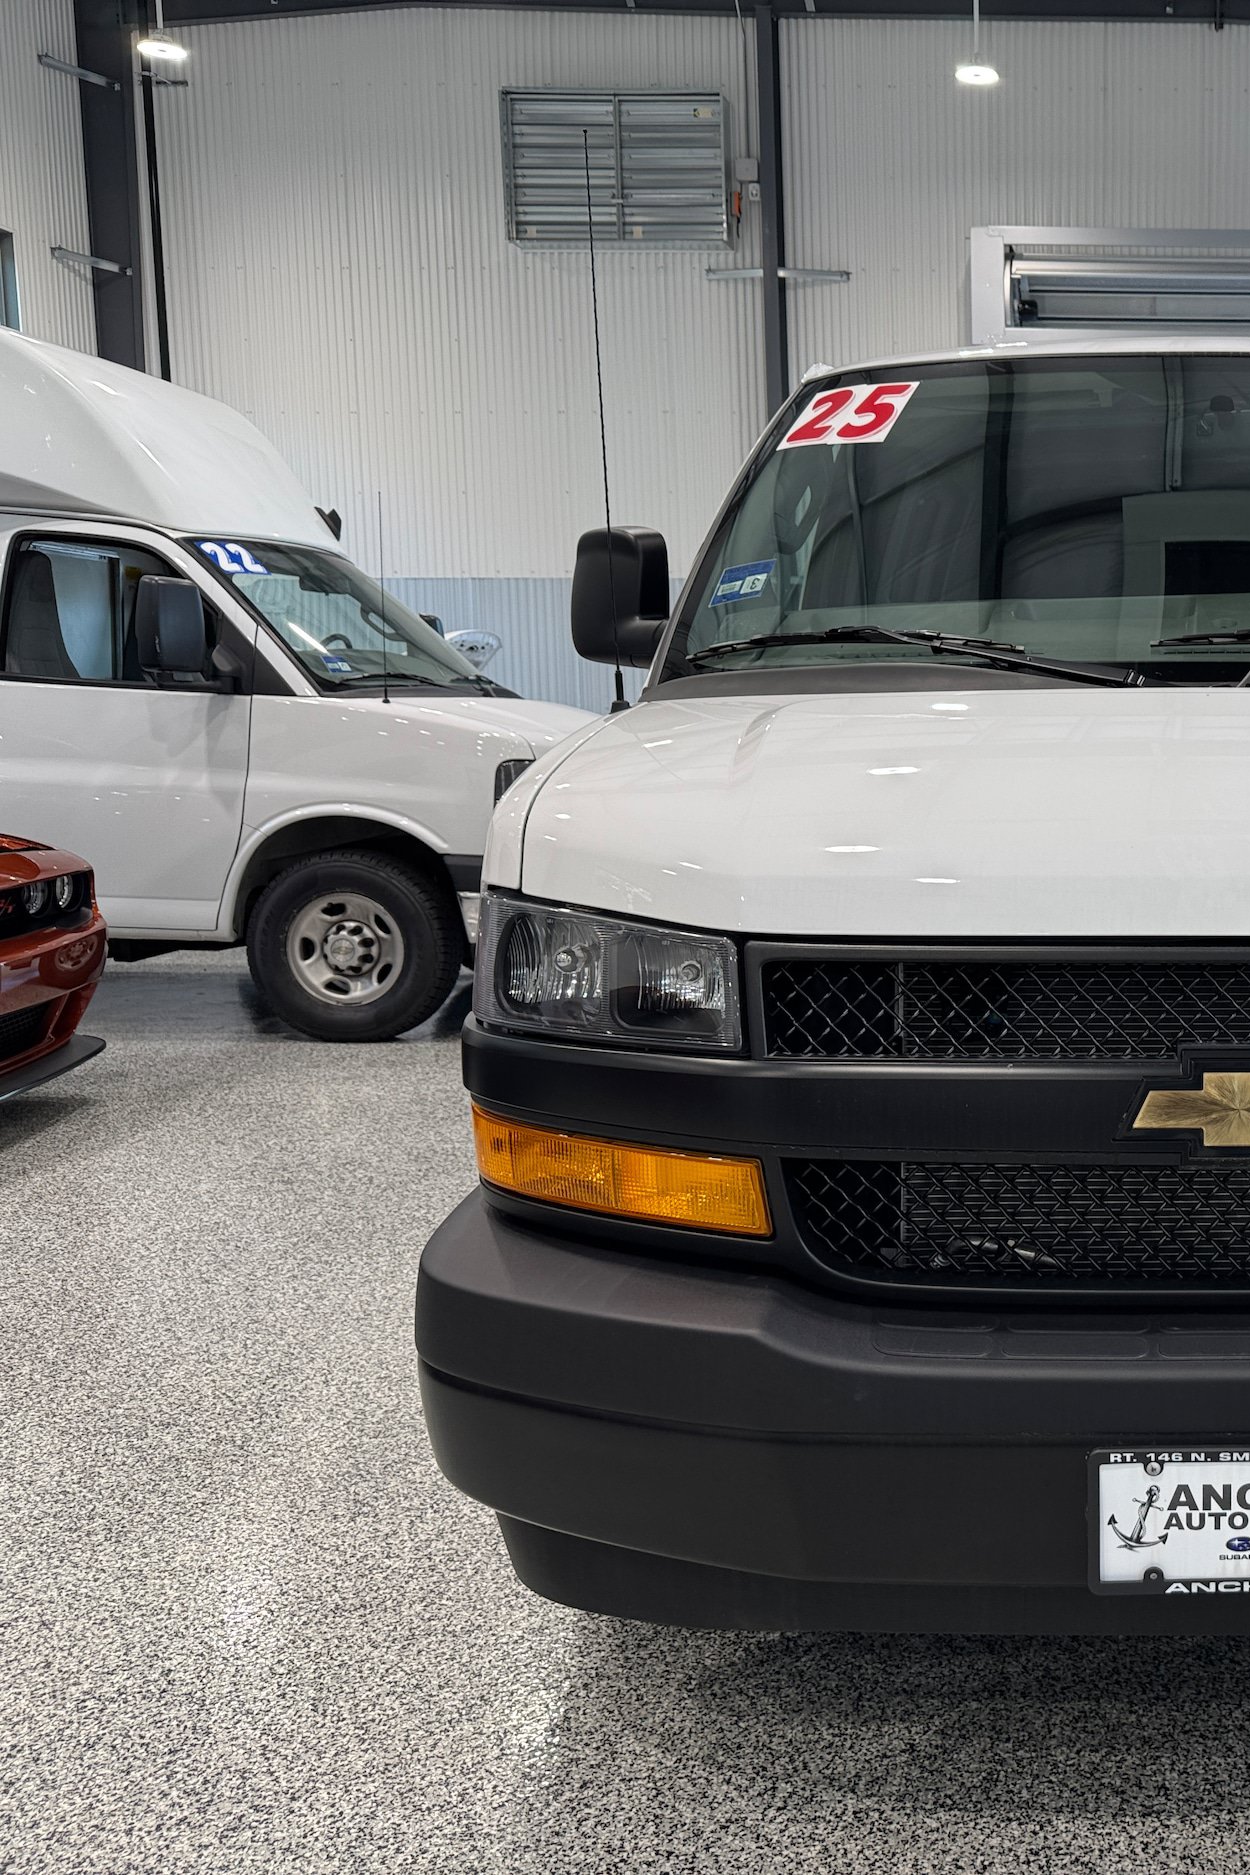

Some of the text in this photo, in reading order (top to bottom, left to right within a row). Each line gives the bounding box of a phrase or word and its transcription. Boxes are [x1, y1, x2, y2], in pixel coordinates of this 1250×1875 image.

[786, 384, 914, 444] 25
[200, 541, 268, 574] 22
[1109, 1452, 1137, 1463] RT.
[1145, 1452, 1183, 1462] 146
[1190, 1452, 1212, 1462] N.
[1163, 1511, 1249, 1531] AUTO
